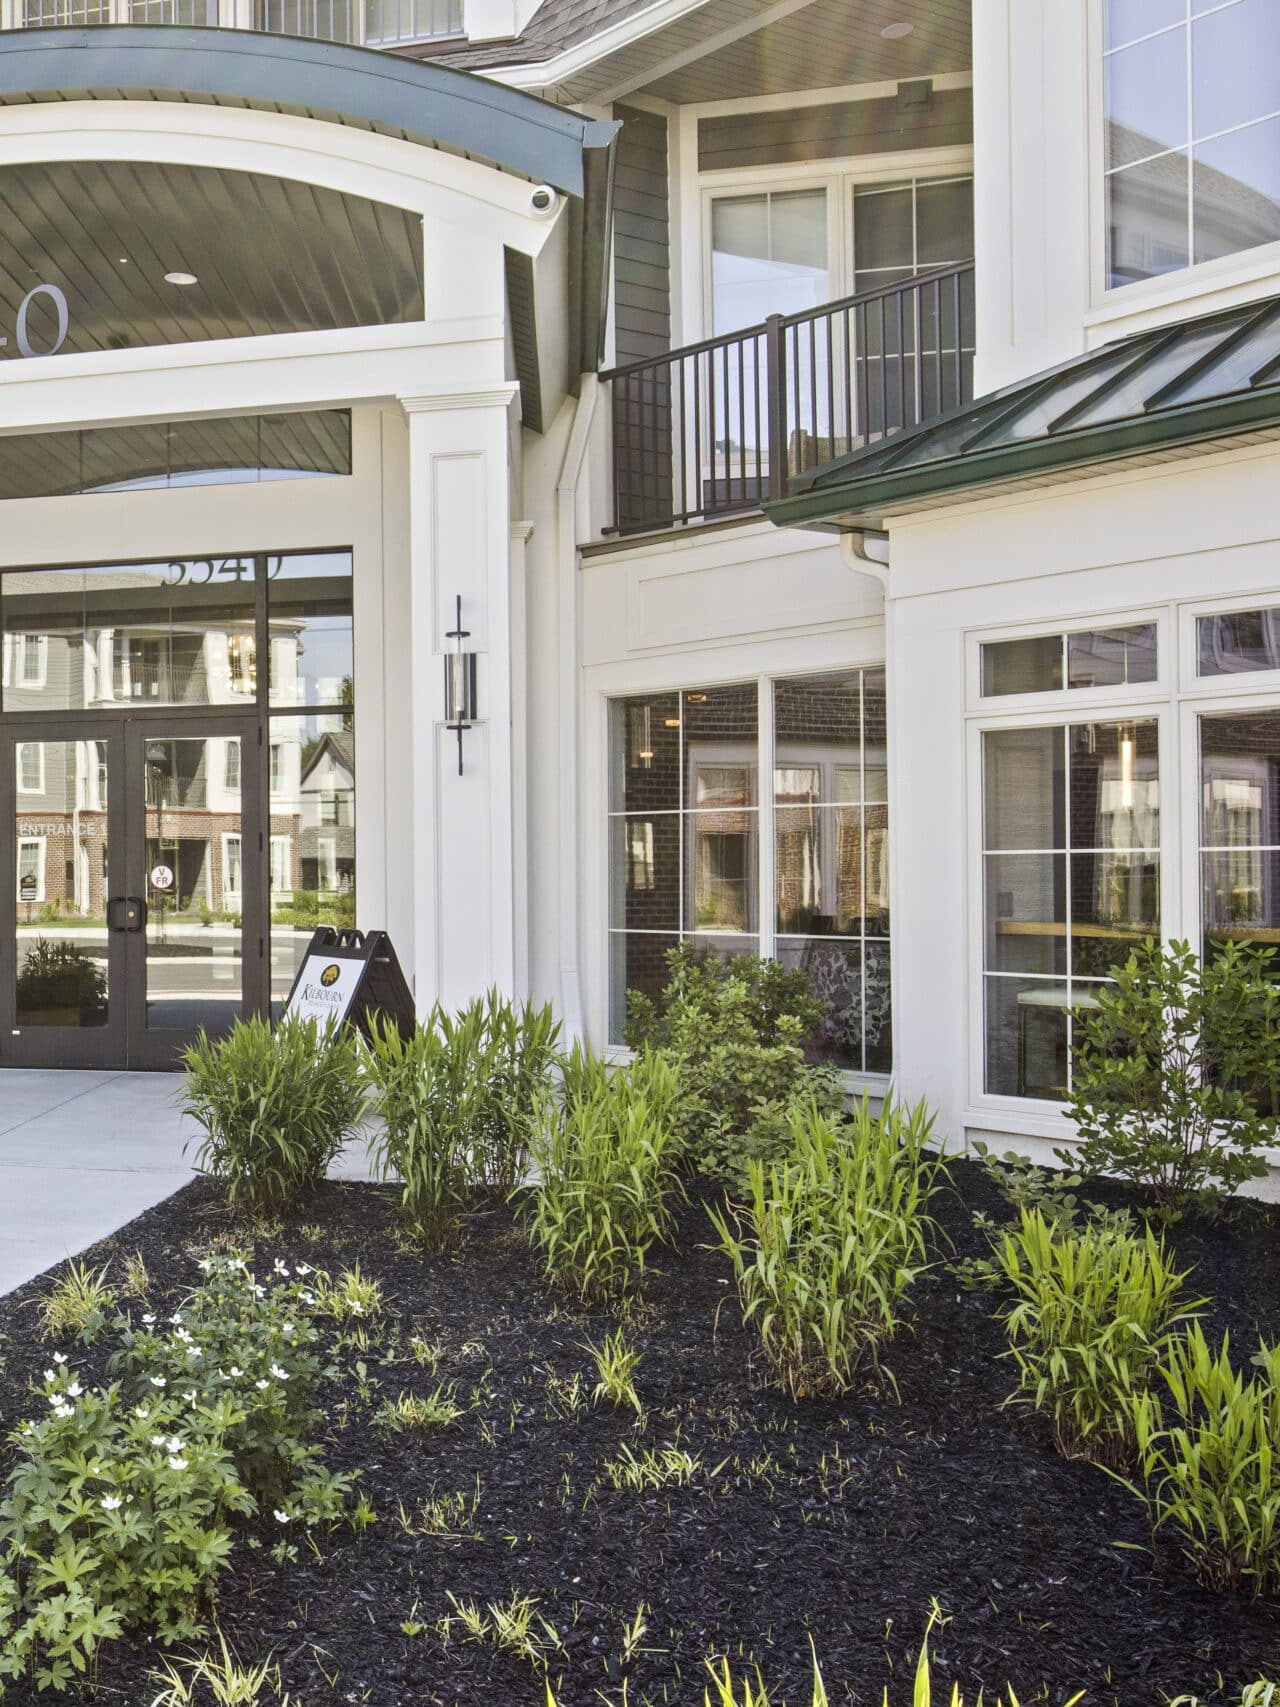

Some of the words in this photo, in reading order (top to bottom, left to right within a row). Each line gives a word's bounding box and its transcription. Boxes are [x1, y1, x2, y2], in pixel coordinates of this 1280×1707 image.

[19, 822, 97, 836] ENTRANCE
[158, 867, 166, 876] V
[155, 876, 169, 885] FR
[301, 983, 345, 1002] KILBOURN
